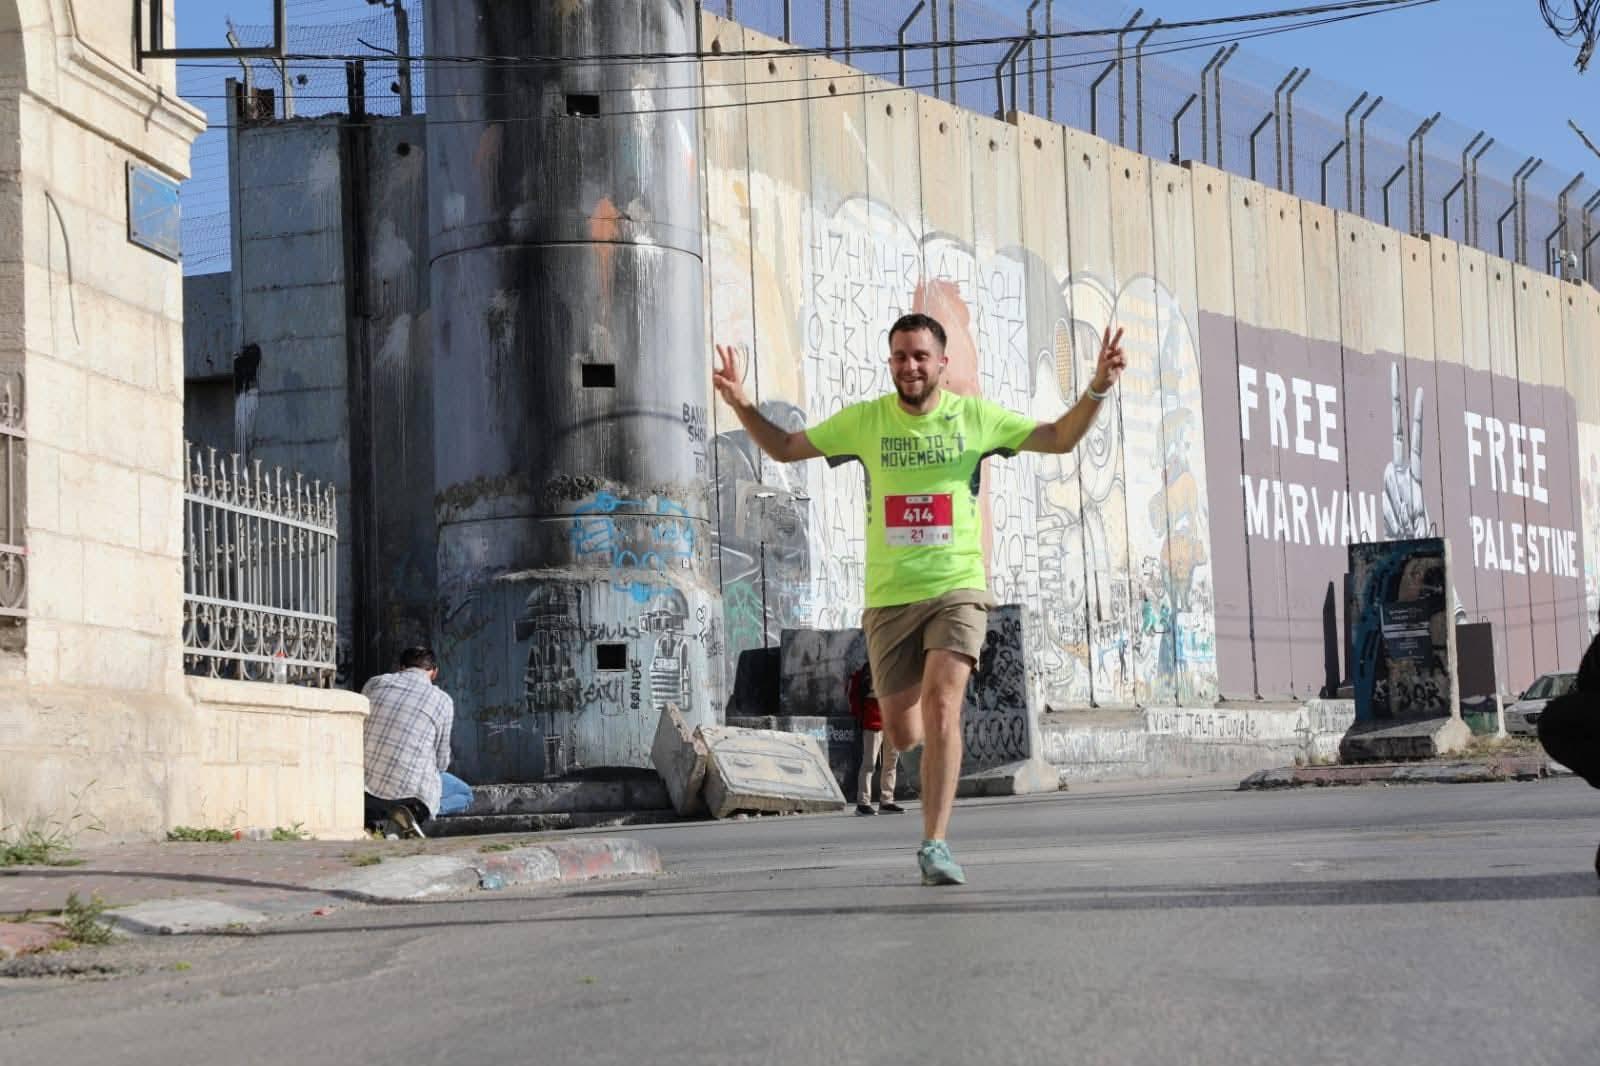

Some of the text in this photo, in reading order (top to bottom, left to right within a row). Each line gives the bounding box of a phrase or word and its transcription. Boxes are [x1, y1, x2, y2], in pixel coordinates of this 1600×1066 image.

[1239, 364, 1339, 463] FREE
[880, 448, 954, 468] MOVEMENT
[881, 434, 944, 452] RIGHT TO
[1464, 411, 1549, 504] FREE
[903, 507, 934, 522] 414
[1240, 474, 1377, 547] MARWAN
[911, 529, 924, 539] 21
[1470, 516, 1579, 578] PALESTINE
